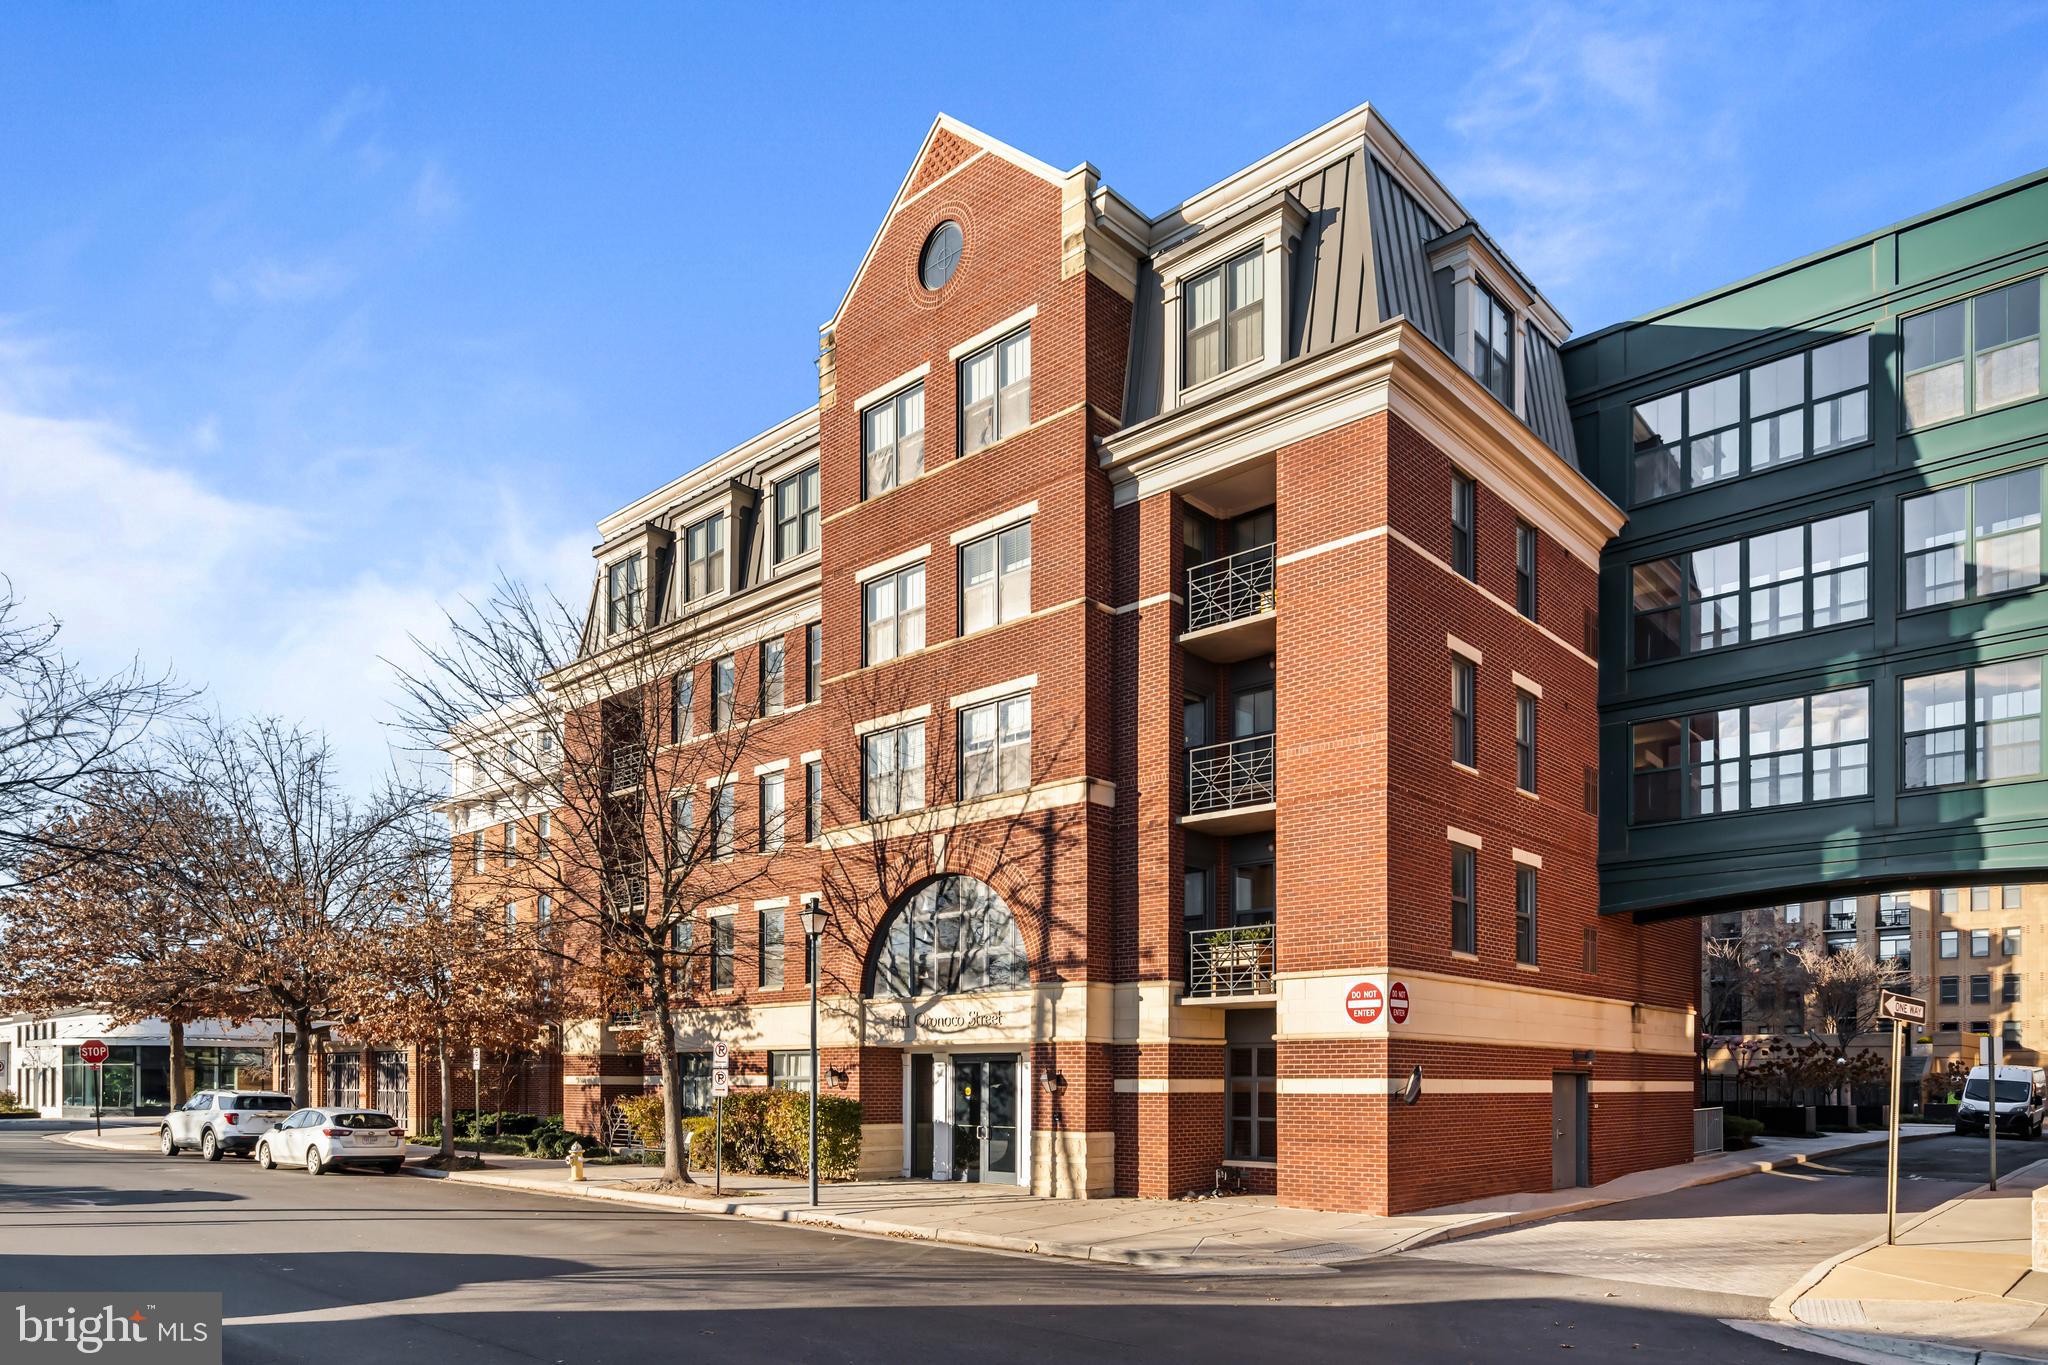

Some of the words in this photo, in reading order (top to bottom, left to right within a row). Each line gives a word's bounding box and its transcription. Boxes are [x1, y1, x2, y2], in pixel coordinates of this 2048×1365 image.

[1364, 990, 1377, 998] NOT
[1392, 990, 1398, 998] DO
[1896, 1002, 1908, 1013] ONE
[1910, 1006, 1922, 1015] WAY
[1354, 1009, 1375, 1017] ENTER
[914, 1013, 964, 1027] Oronoco
[968, 1010, 1003, 1026] Street
[82, 1047, 106, 1056] STOP
